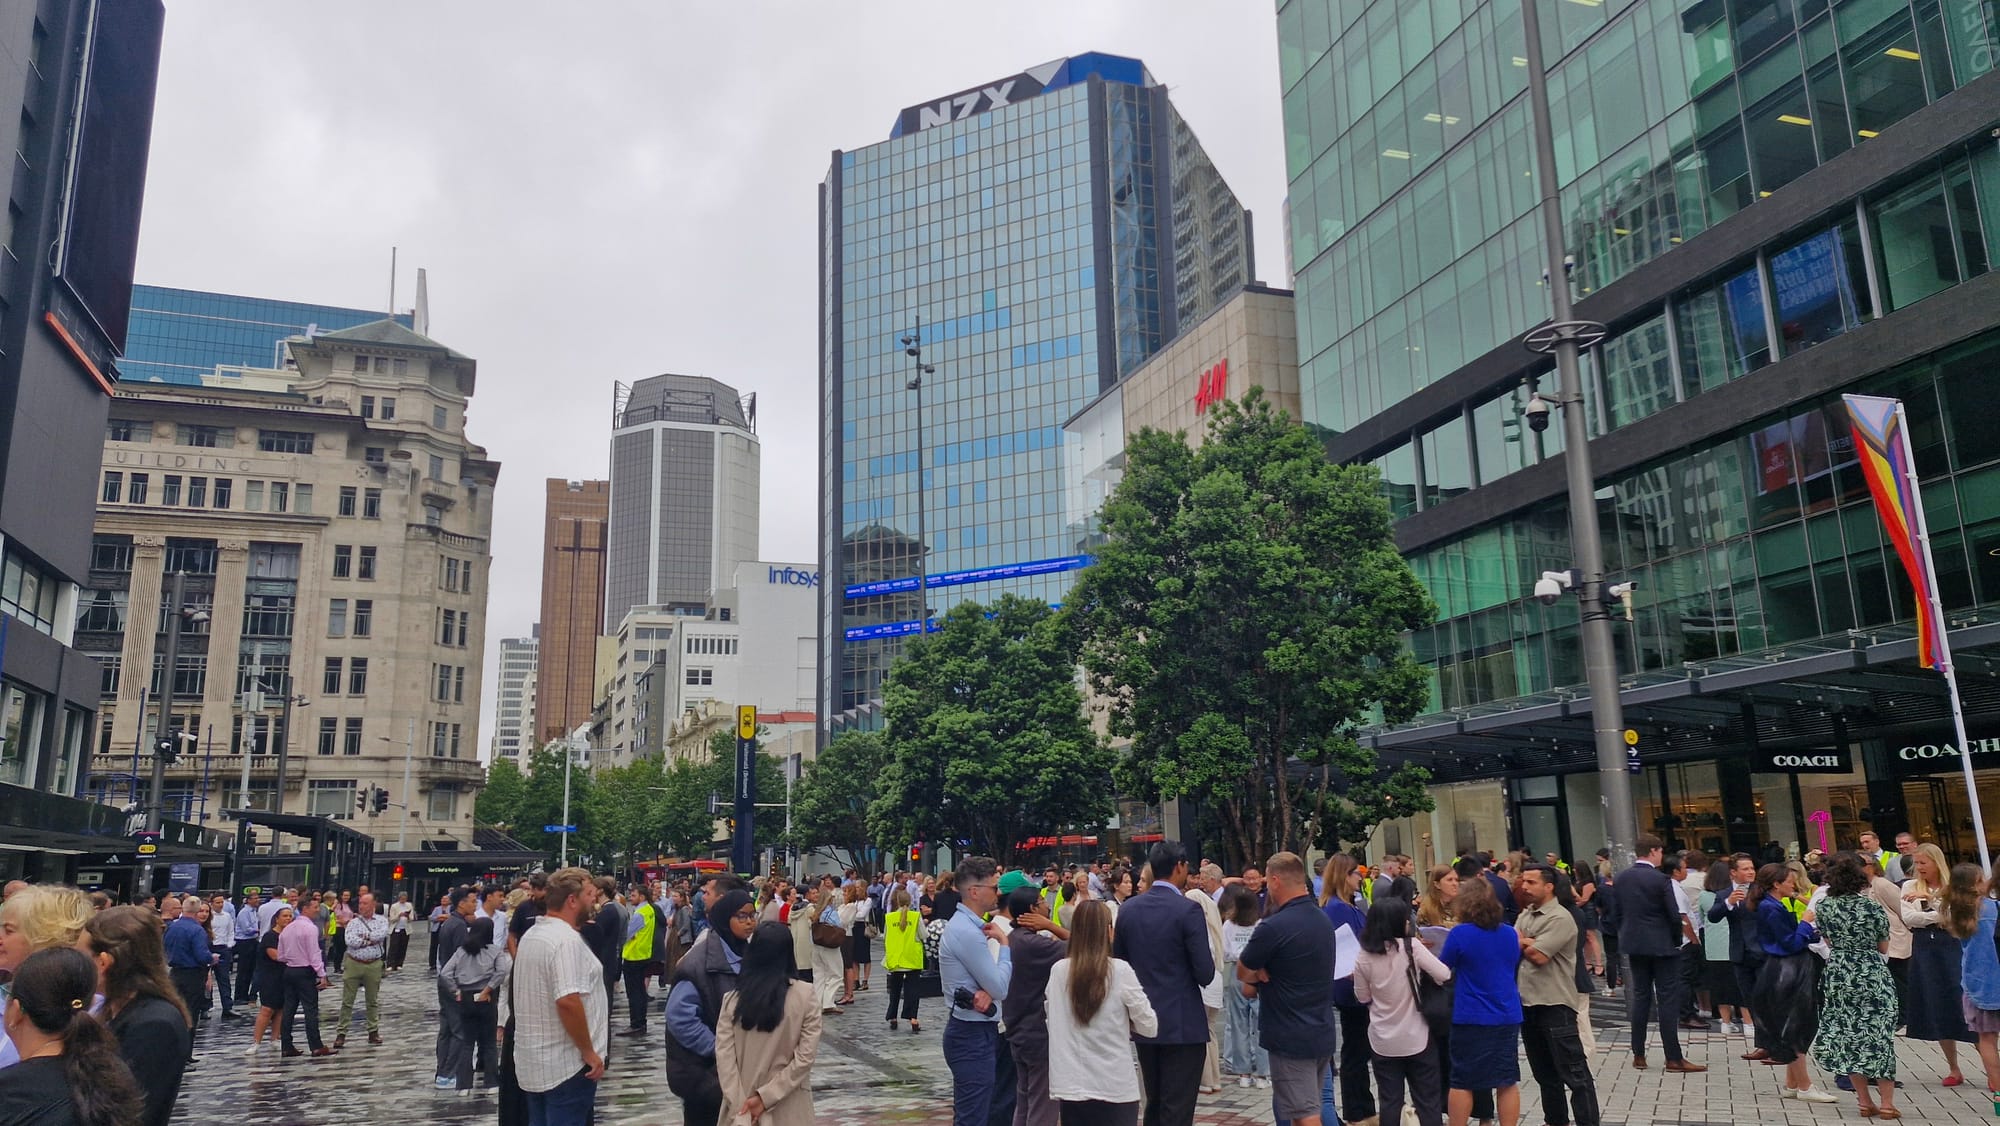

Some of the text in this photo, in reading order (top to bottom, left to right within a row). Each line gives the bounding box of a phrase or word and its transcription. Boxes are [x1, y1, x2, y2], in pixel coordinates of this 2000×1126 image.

[1194, 357, 1228, 417] H&M
[1773, 755, 1839, 767] COACH
[1899, 738, 2000, 761] COACH
